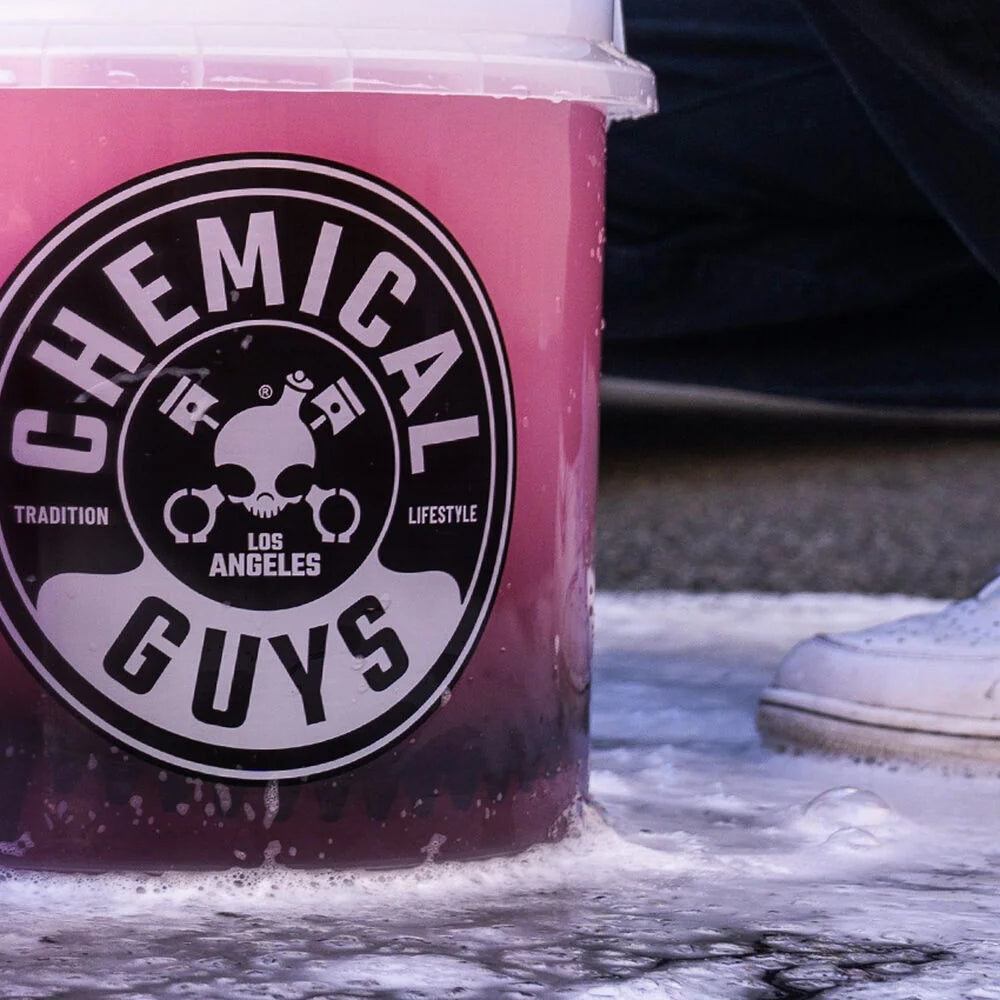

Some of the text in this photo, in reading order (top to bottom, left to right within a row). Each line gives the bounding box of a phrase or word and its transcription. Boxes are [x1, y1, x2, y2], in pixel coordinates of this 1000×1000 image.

[11, 211, 480, 475] CHEMICAL
[14, 504, 110, 526] TRADITION
[408, 504, 479, 525] LIFESTYLE
[247, 532, 283, 551] LOS
[208, 552, 321, 577] ANGELES
[103, 594, 411, 729] GUYS
